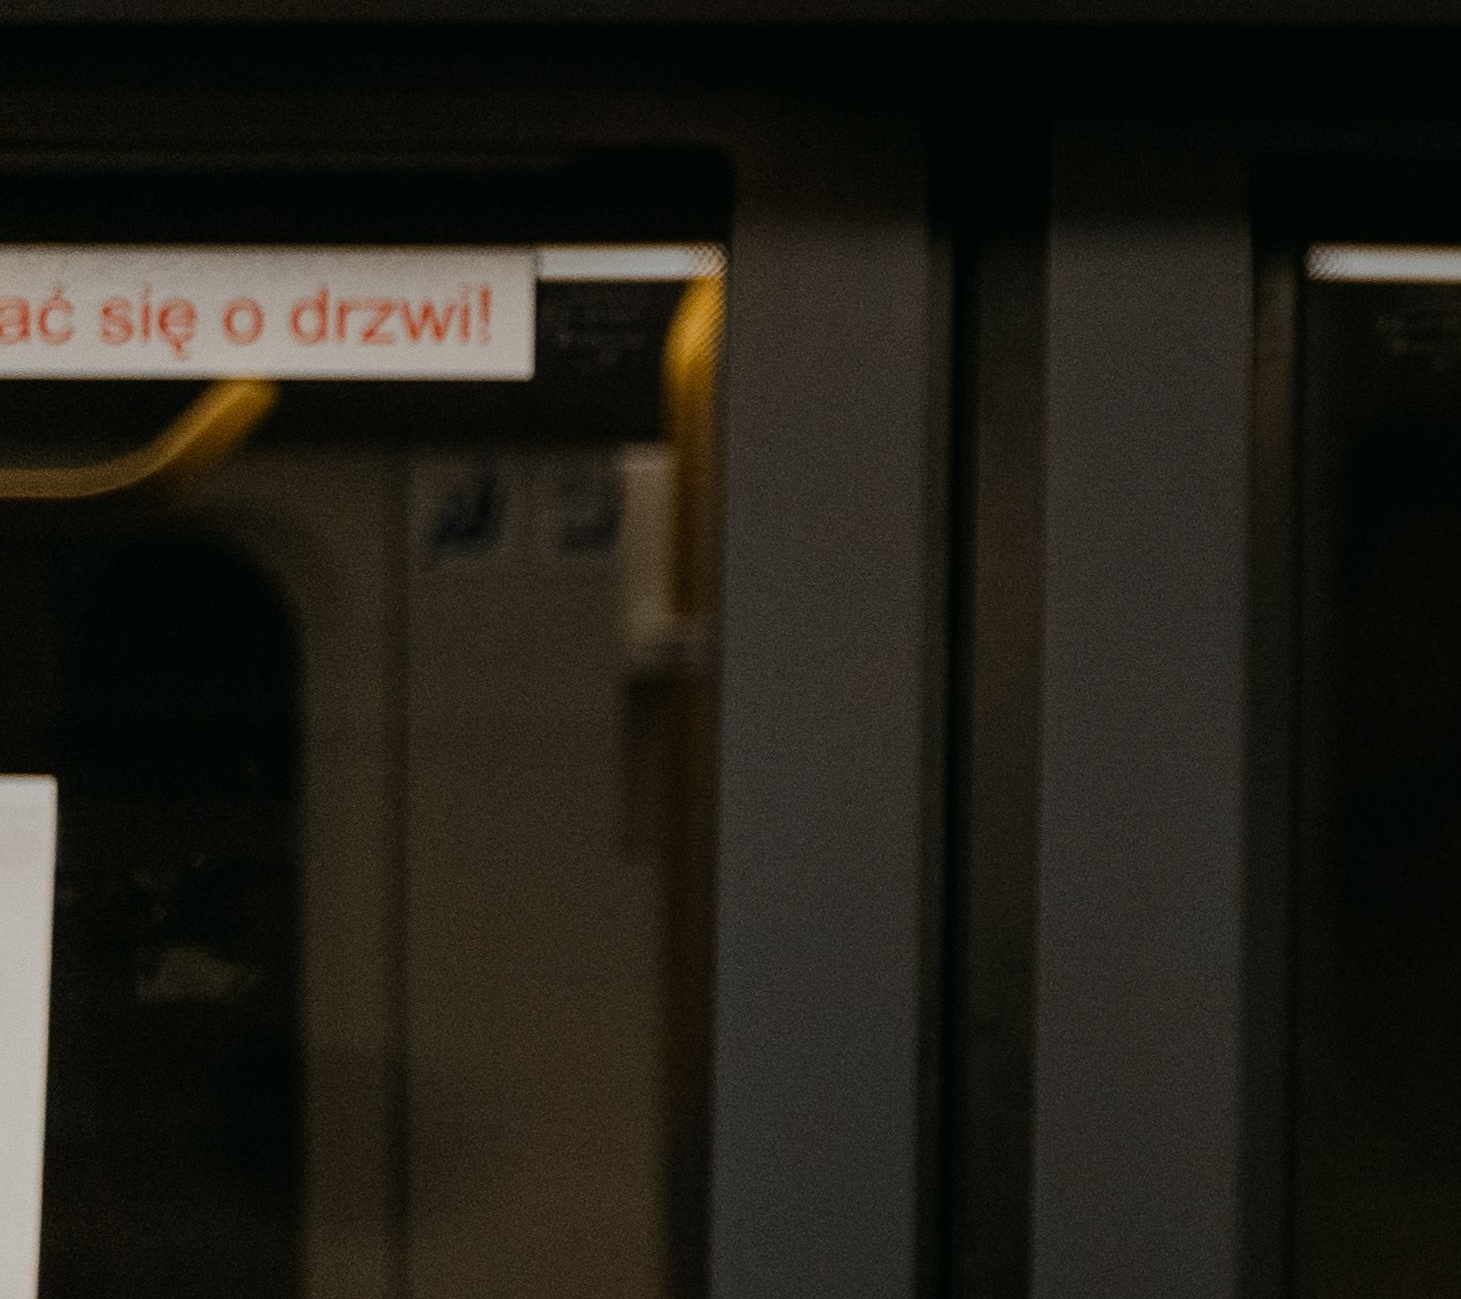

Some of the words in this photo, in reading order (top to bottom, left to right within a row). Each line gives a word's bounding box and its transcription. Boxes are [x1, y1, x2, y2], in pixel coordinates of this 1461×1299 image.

[100, 284, 197, 361] się
[222, 297, 265, 347] o
[290, 284, 493, 347] drzwi!
